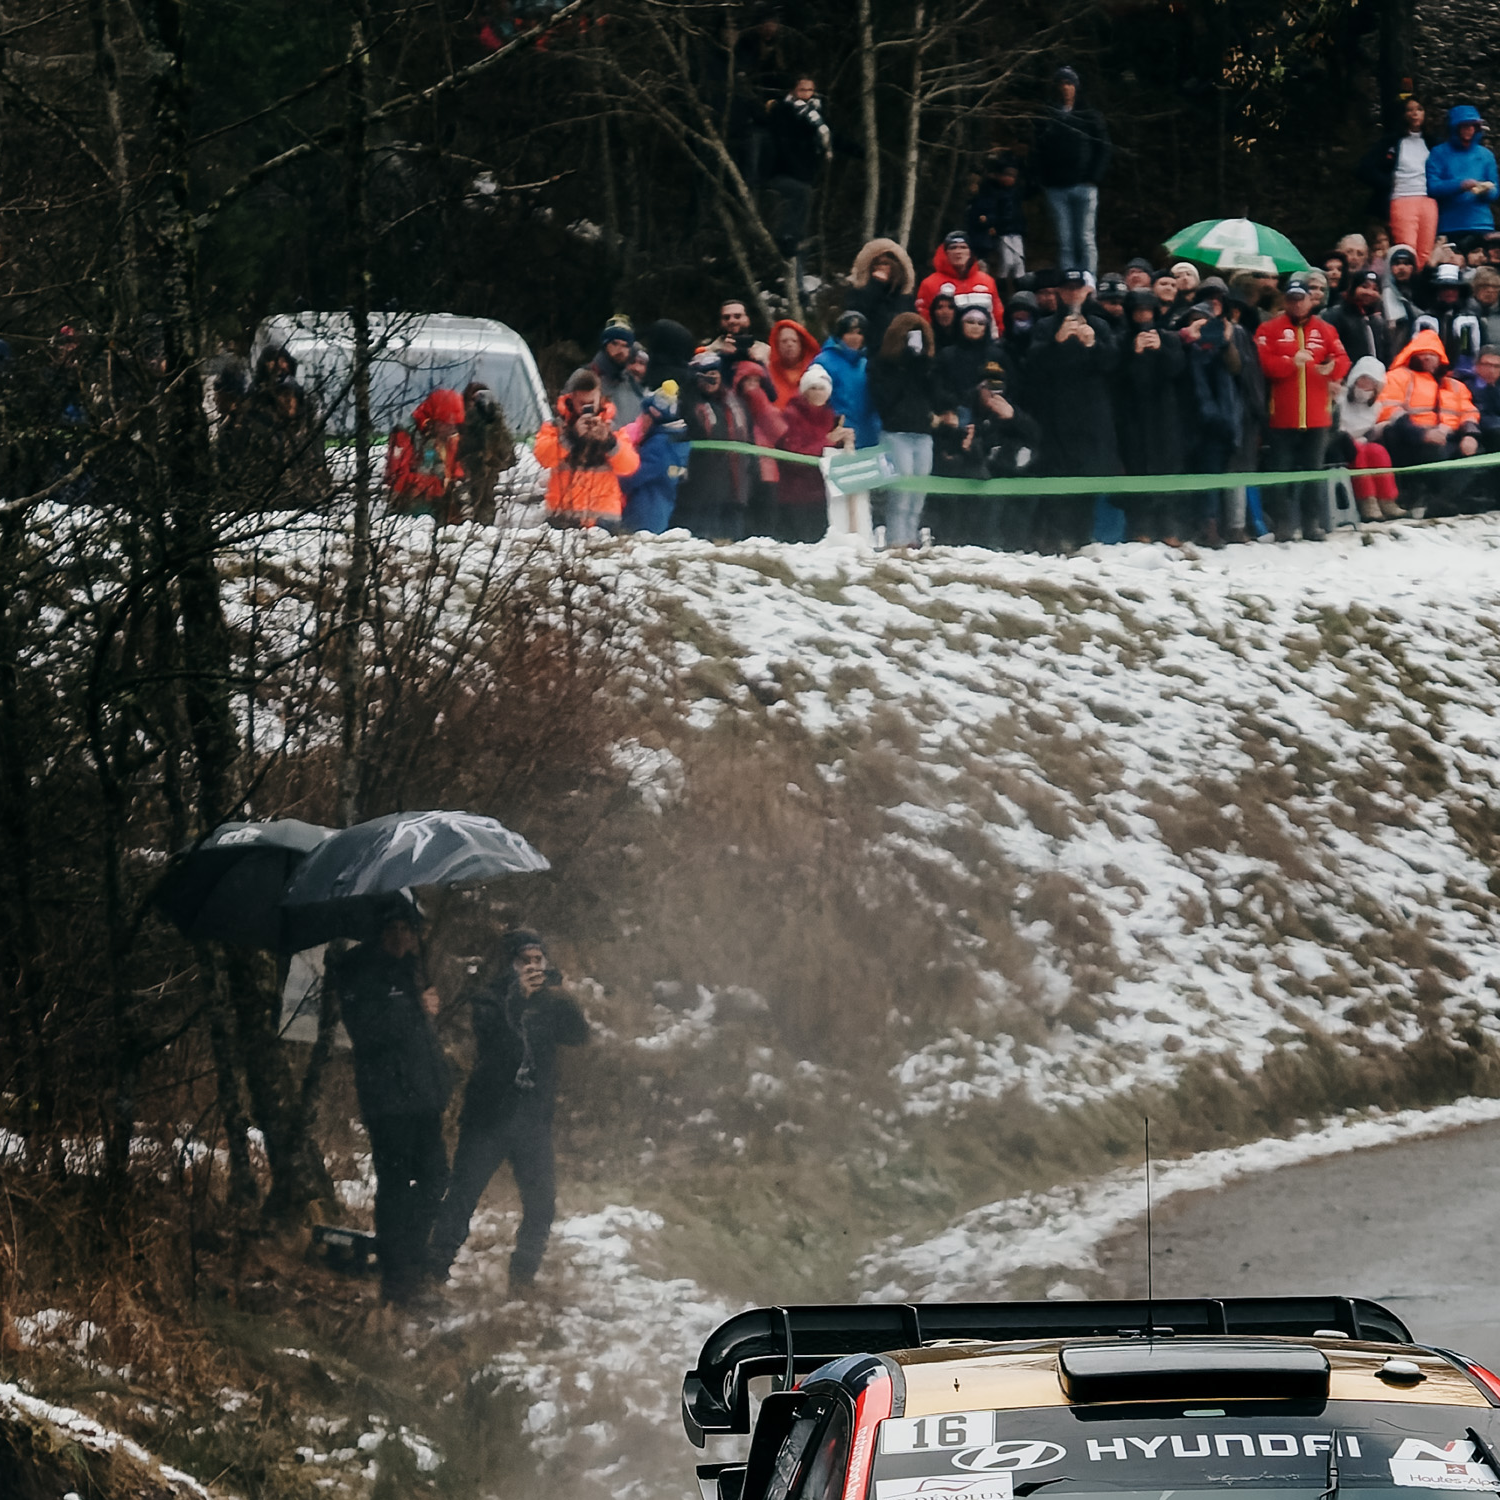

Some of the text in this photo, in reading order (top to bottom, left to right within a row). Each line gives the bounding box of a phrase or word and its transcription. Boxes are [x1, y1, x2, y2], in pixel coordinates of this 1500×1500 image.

[912, 1415, 967, 1449] 16
[1086, 1434, 1362, 1461] HYUNDAI
[1409, 1474, 1500, 1487] Hautes-Alpe
